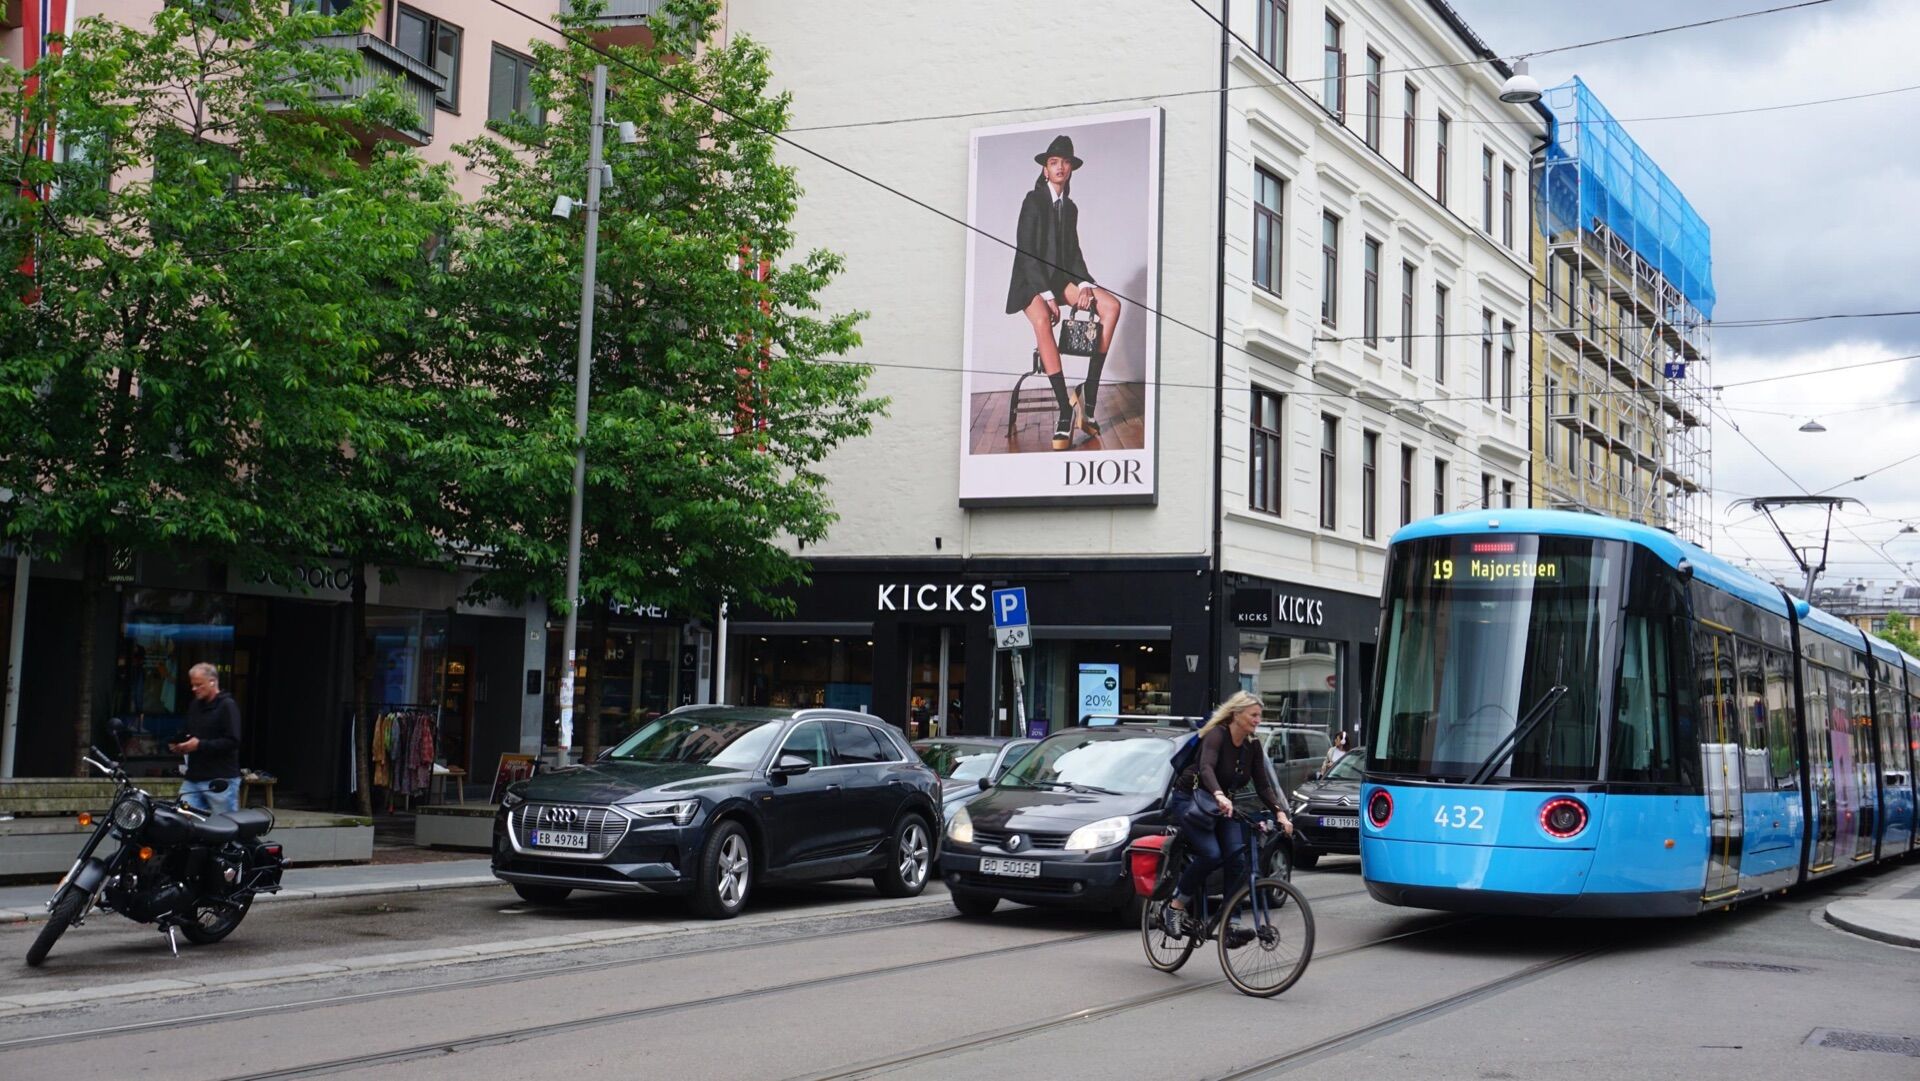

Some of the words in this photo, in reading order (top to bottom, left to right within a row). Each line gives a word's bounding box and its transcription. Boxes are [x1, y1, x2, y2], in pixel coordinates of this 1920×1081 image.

[1064, 459, 1143, 486] DIOR
[1433, 559, 1453, 579] 19
[1471, 560, 1556, 581] Majorstuen
[878, 584, 987, 611] KICKS
[1000, 593, 1018, 622] P
[1238, 613, 1268, 622] KICKS
[1278, 594, 1323, 625] KICKS
[1085, 694, 1112, 707] 20%
[1434, 804, 1484, 829] 432
[539, 832, 551, 844] EB
[554, 834, 584, 847] 49784
[1002, 861, 1038, 874] 50164
